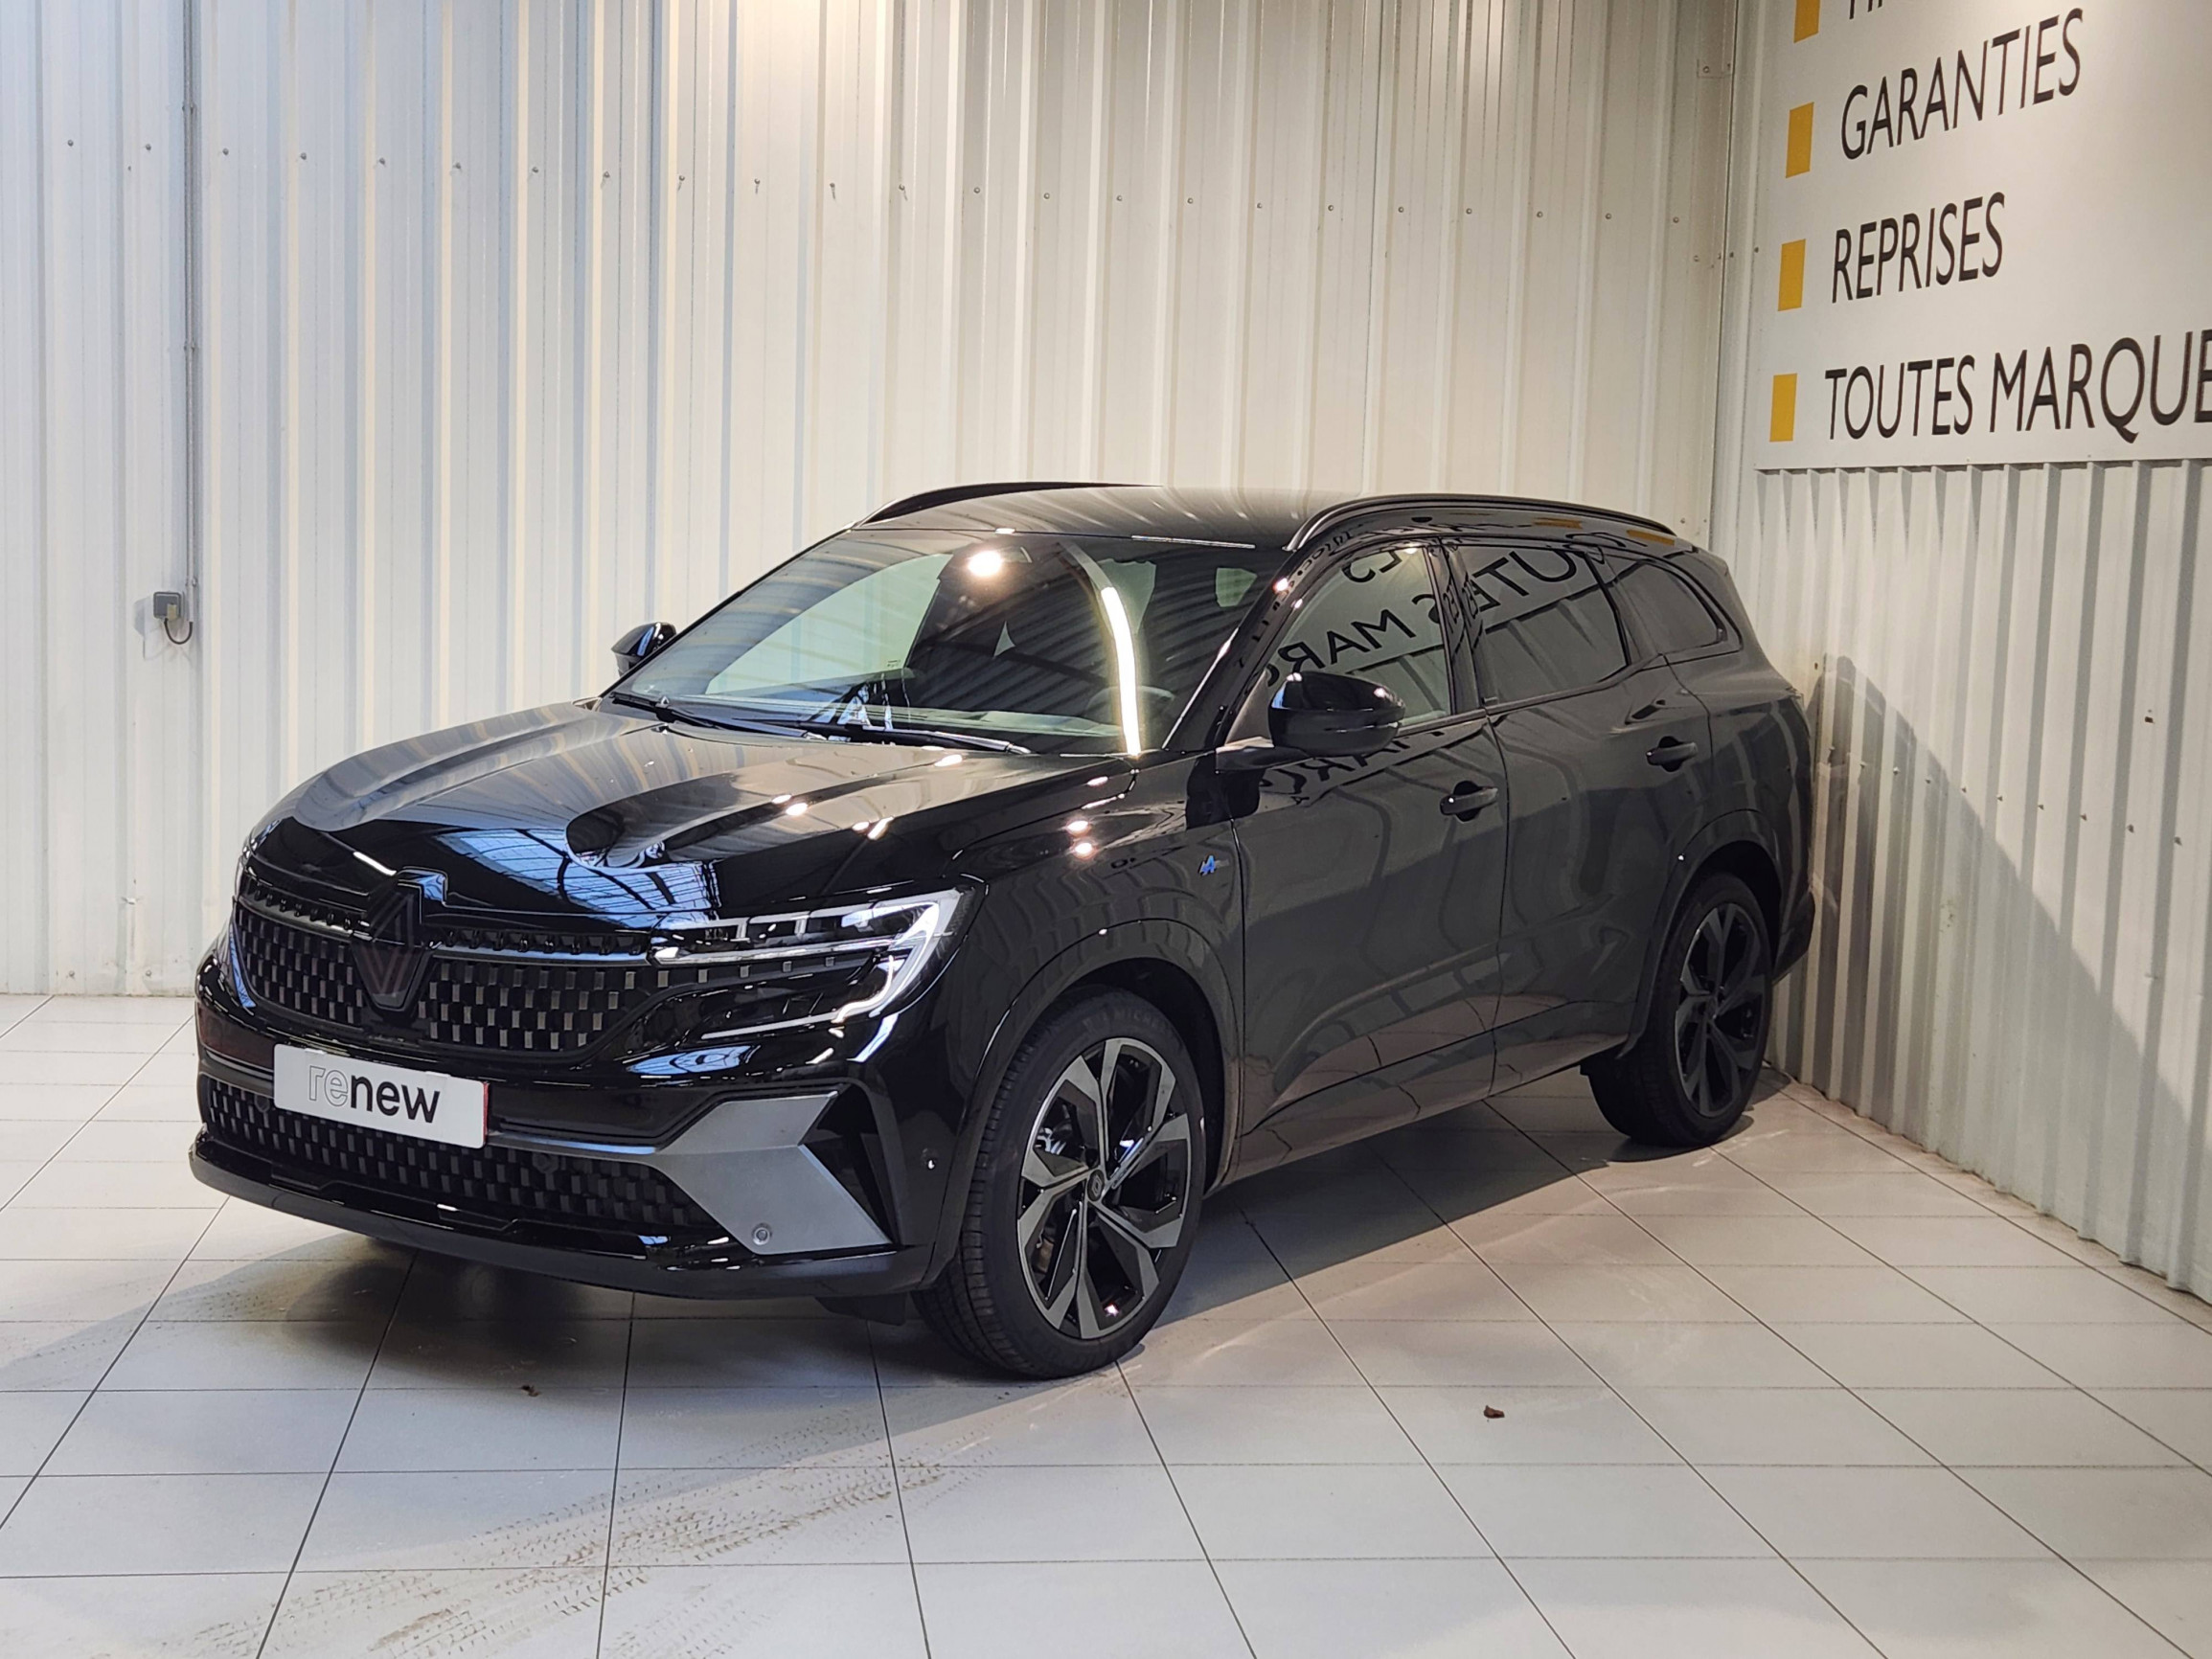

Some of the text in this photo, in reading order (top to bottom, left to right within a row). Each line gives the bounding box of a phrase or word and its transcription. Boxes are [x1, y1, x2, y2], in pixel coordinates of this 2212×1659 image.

[1840, 8, 2084, 160] GARANTIES
[1832, 192, 2005, 304] REPRISES
[1824, 354, 1975, 440] TOUTES
[308, 1064, 441, 1124] renew
